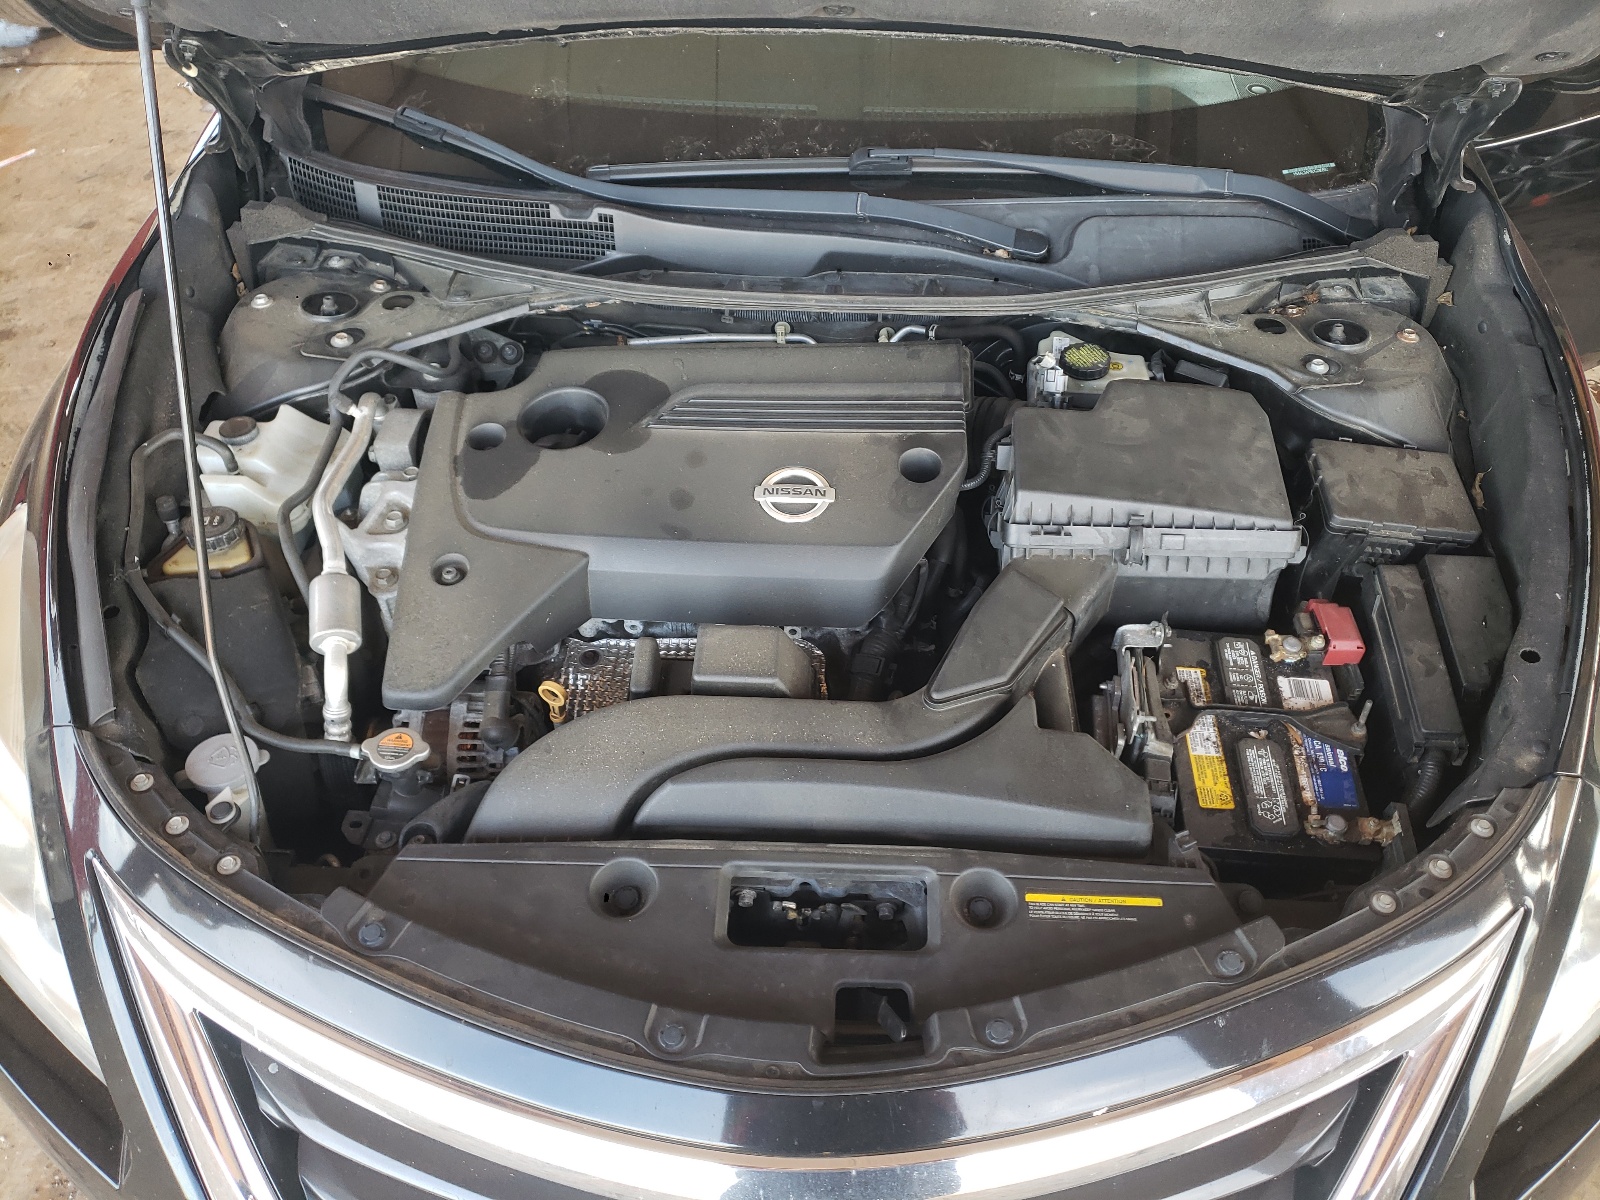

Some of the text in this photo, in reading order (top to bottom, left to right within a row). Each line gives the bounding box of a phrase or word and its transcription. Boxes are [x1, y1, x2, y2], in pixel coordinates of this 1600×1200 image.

[762, 487, 826, 497] NISSAN
[1258, 683, 1268, 705] POISON
[1337, 748, 1349, 772] elco
